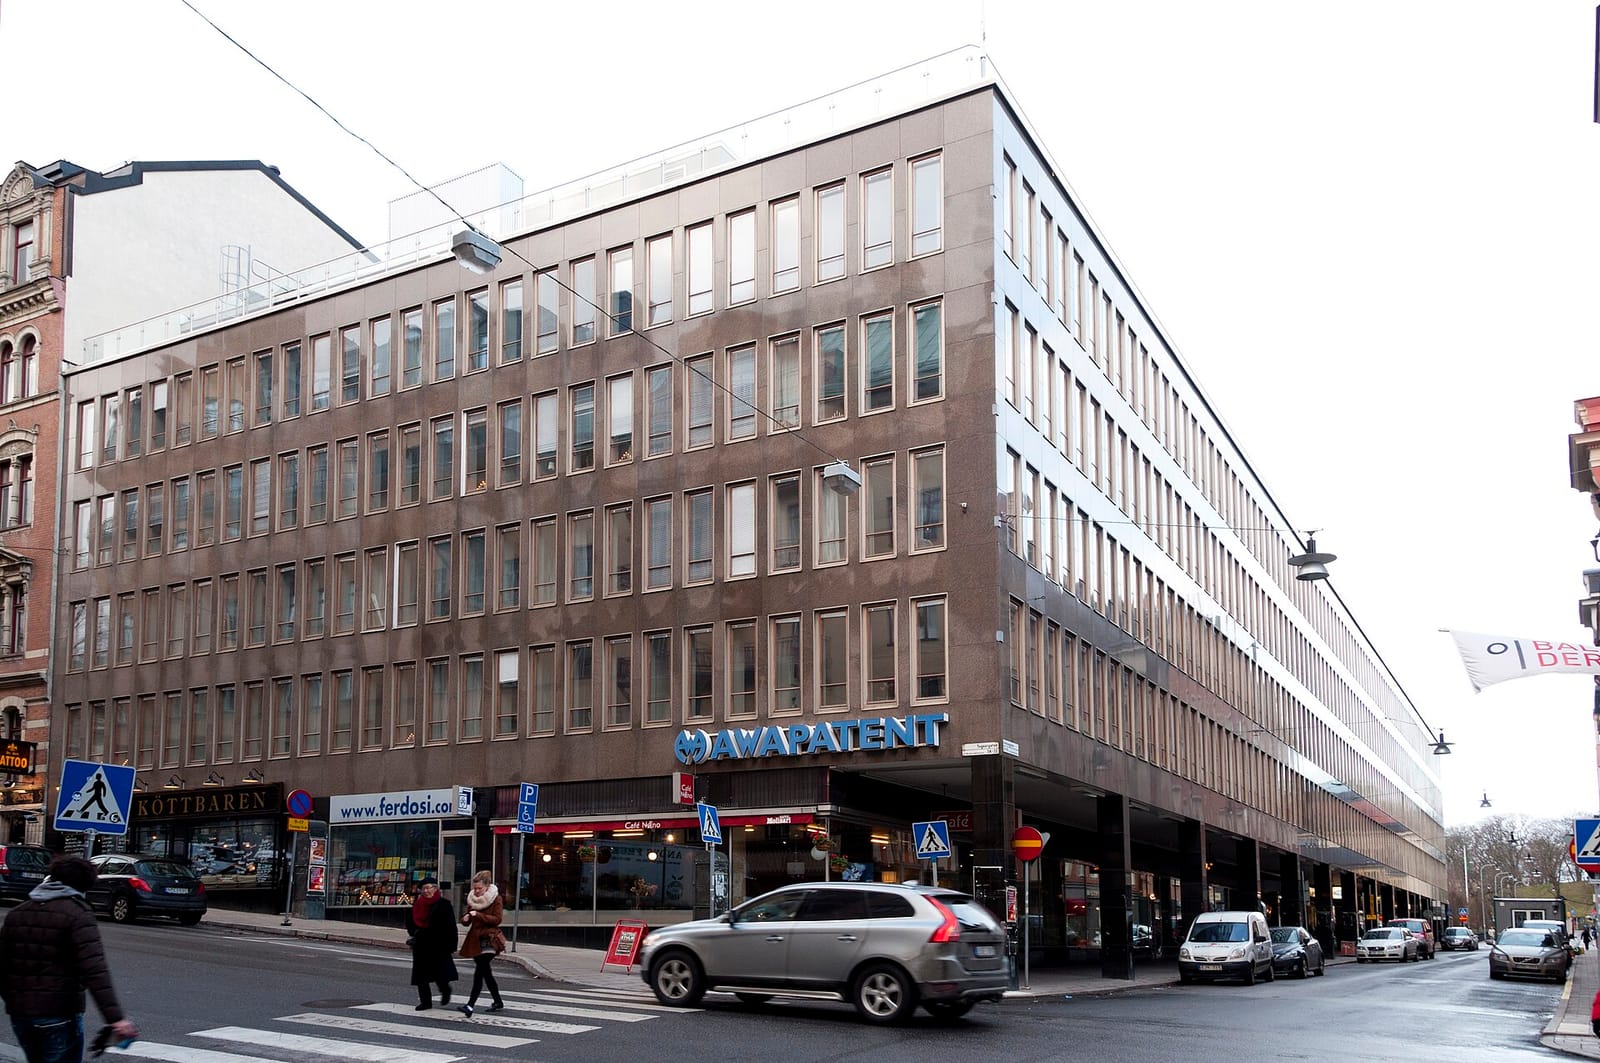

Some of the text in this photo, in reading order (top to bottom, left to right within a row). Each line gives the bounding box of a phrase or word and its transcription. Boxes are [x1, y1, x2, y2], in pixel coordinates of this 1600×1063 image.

[710, 712, 949, 760] AWAPATENT
[137, 791, 266, 816] KÖTTBAREN
[525, 786, 535, 801] P
[341, 795, 452, 818] www.ferdosi.co
[624, 821, 640, 829] Café
